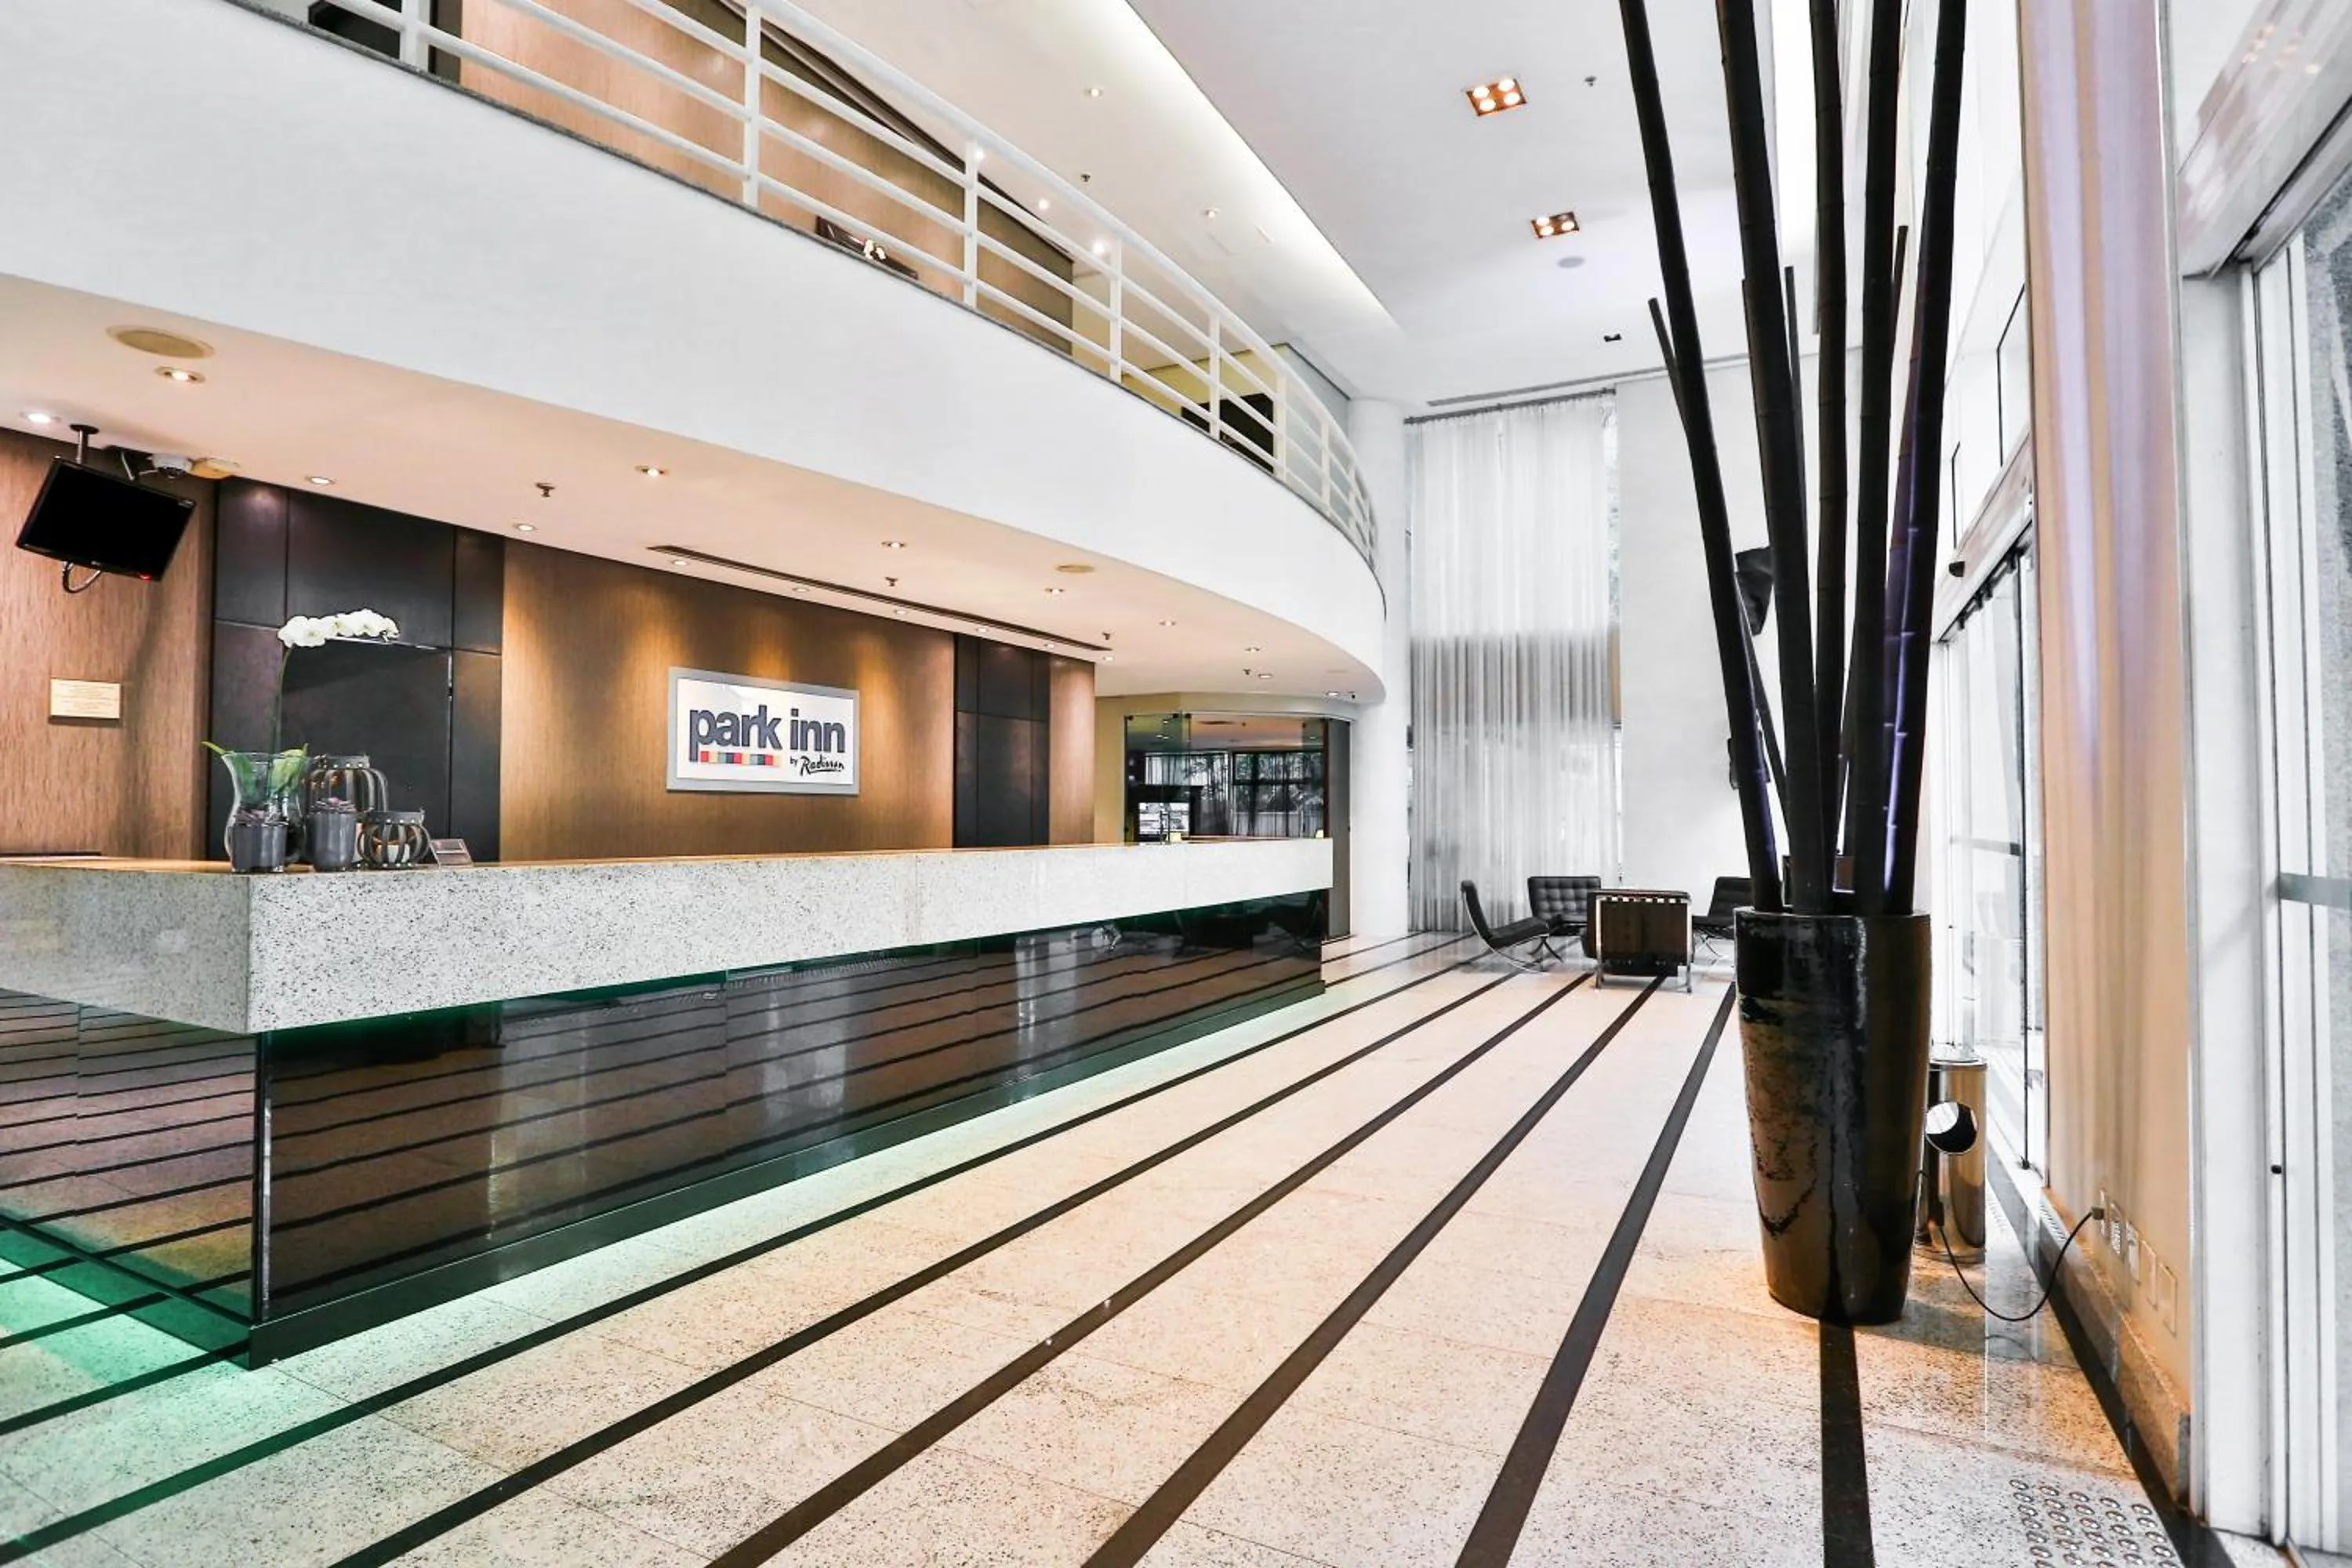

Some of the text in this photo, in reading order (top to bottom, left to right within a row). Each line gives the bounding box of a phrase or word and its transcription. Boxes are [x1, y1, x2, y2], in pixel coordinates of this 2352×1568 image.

[689, 704, 845, 762] park inn
[789, 756, 798, 766] by
